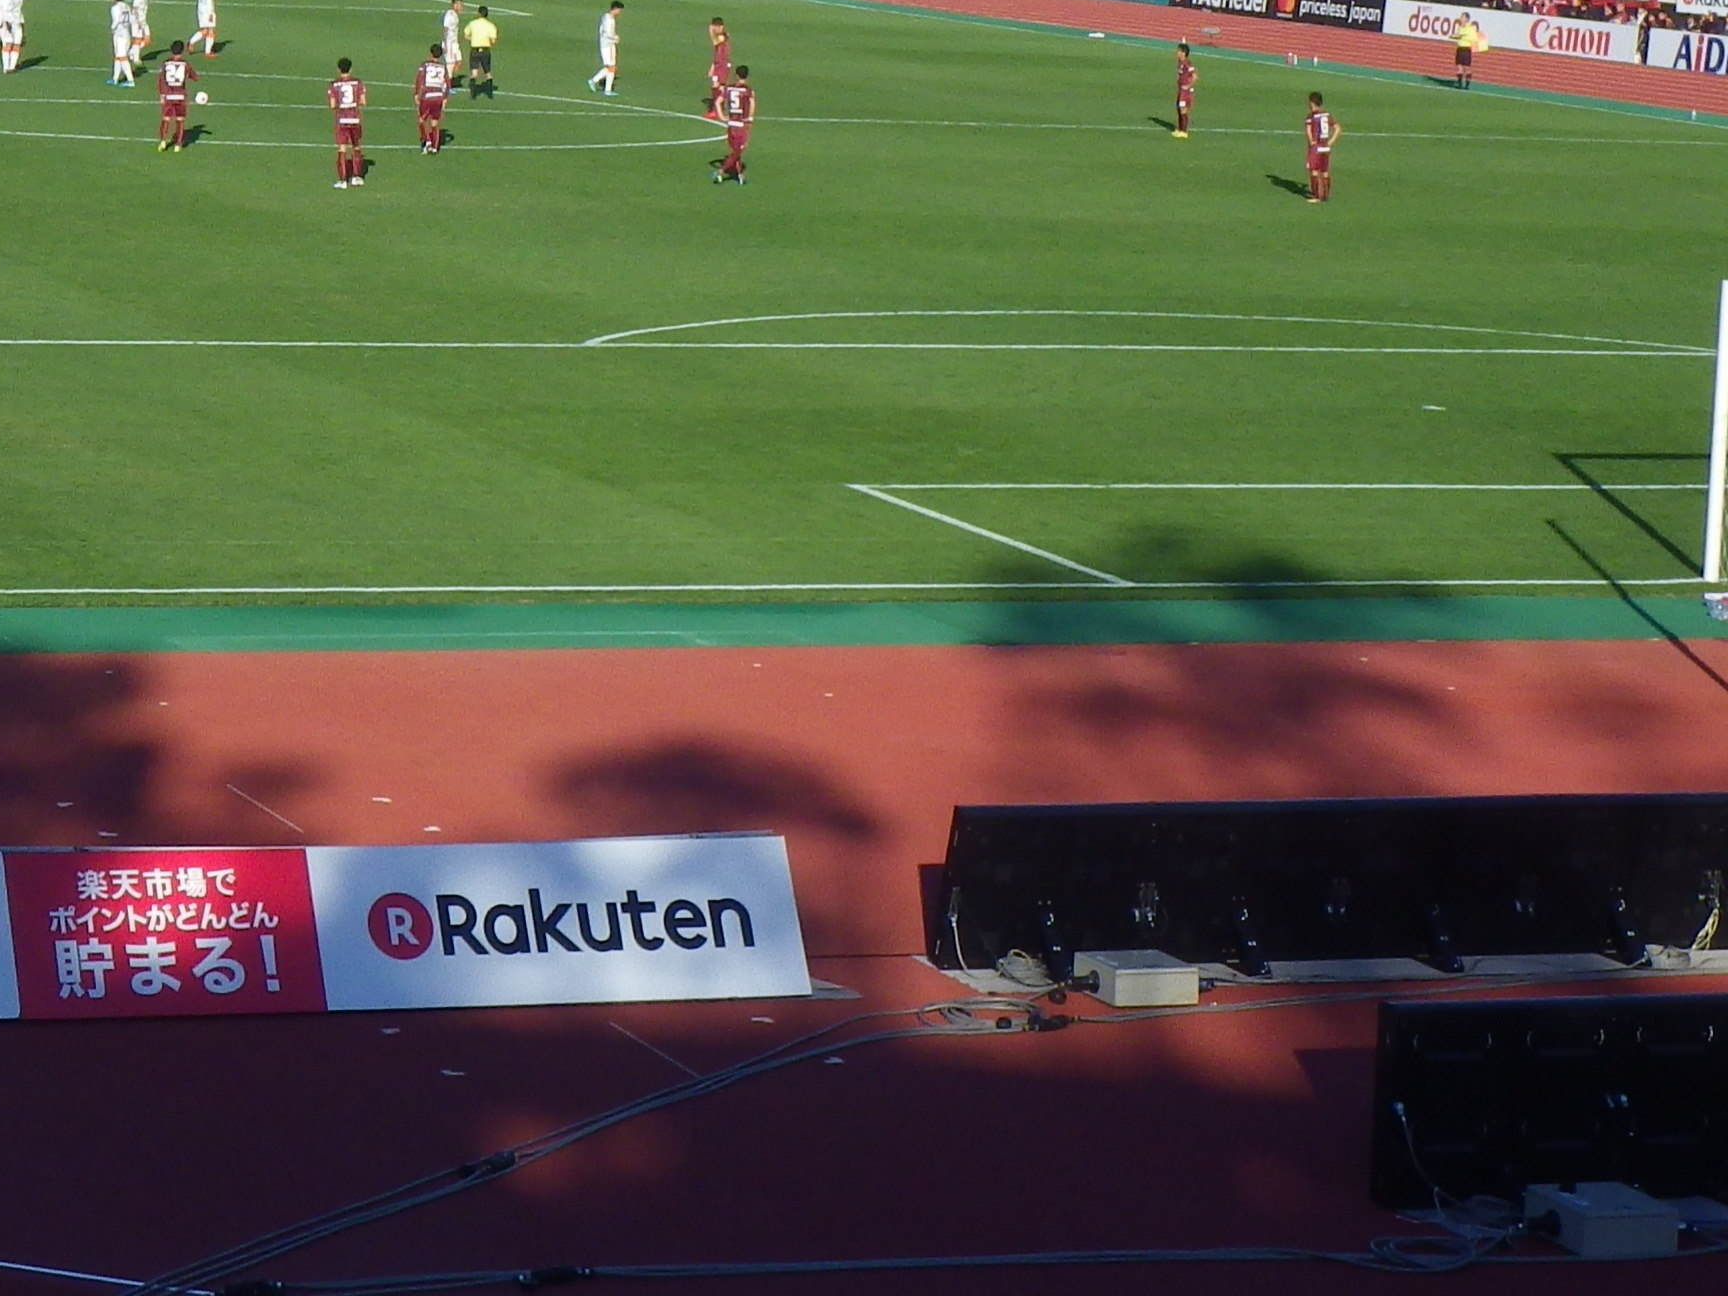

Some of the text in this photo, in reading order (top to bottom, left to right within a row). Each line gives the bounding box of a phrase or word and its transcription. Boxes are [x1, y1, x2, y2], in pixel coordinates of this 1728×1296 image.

[1348, 3, 1381, 25] japan
[1529, 18, 1611, 56] Canon
[424, 66, 446, 88] 23
[340, 84, 354, 104] 3
[729, 91, 740, 109] 5
[1319, 116, 1329, 139] 6
[77, 867, 235, 900] 楽天市場で
[49, 901, 278, 934] ポイントがどんどん
[434, 888, 755, 957] Rakuten
[54, 934, 281, 999] 貯まる！
